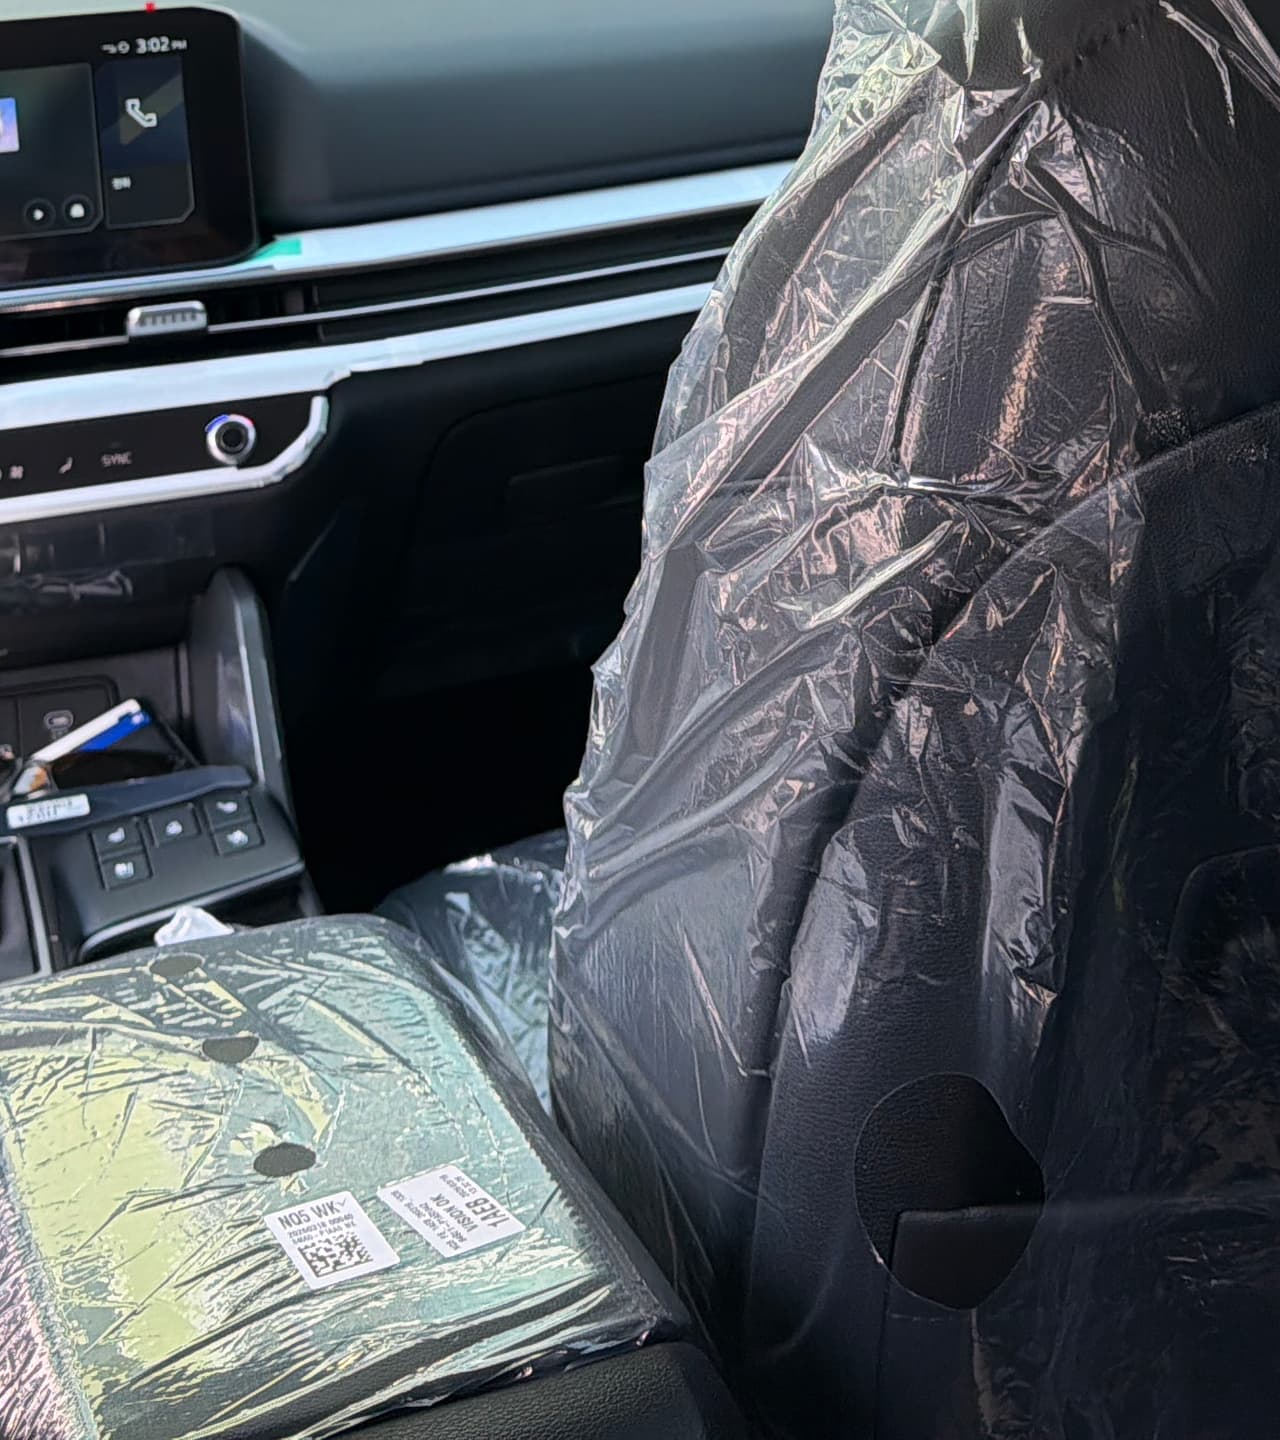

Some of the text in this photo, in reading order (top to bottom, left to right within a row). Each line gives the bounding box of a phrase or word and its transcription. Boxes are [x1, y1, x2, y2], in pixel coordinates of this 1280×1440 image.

[136, 36, 170, 54] 3:02
[101, 452, 132, 467] SYNC
[429, 1192, 451, 1208] OK
[277, 1200, 341, 1230] NQ5 WK
[444, 1204, 479, 1233] VISION
[465, 1197, 510, 1228] 1AEB
